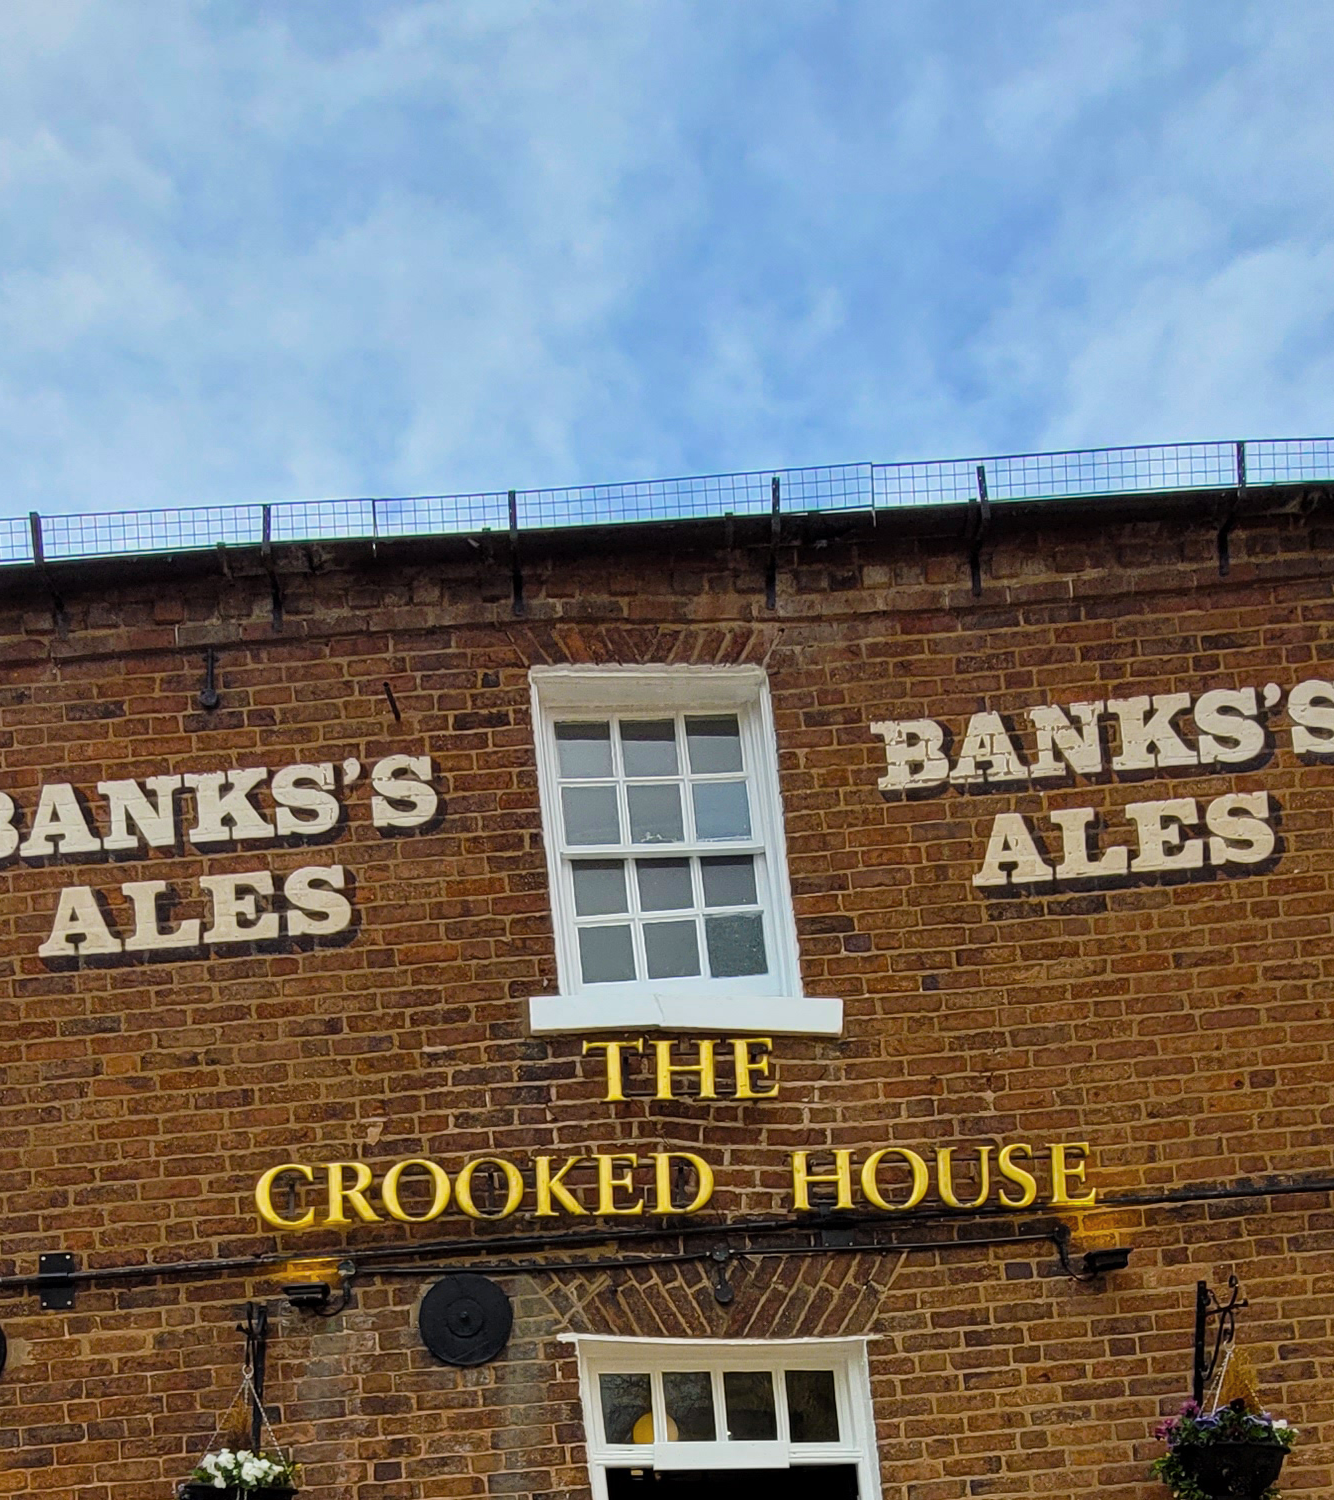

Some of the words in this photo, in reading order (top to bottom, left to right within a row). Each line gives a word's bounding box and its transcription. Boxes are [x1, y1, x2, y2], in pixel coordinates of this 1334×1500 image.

[973, 790, 1275, 886] ALES
[39, 864, 352, 958] ALES
[582, 1037, 780, 1102] THE
[256, 1152, 714, 1230] CROOKED
[792, 1141, 1099, 1212] HOUSE
